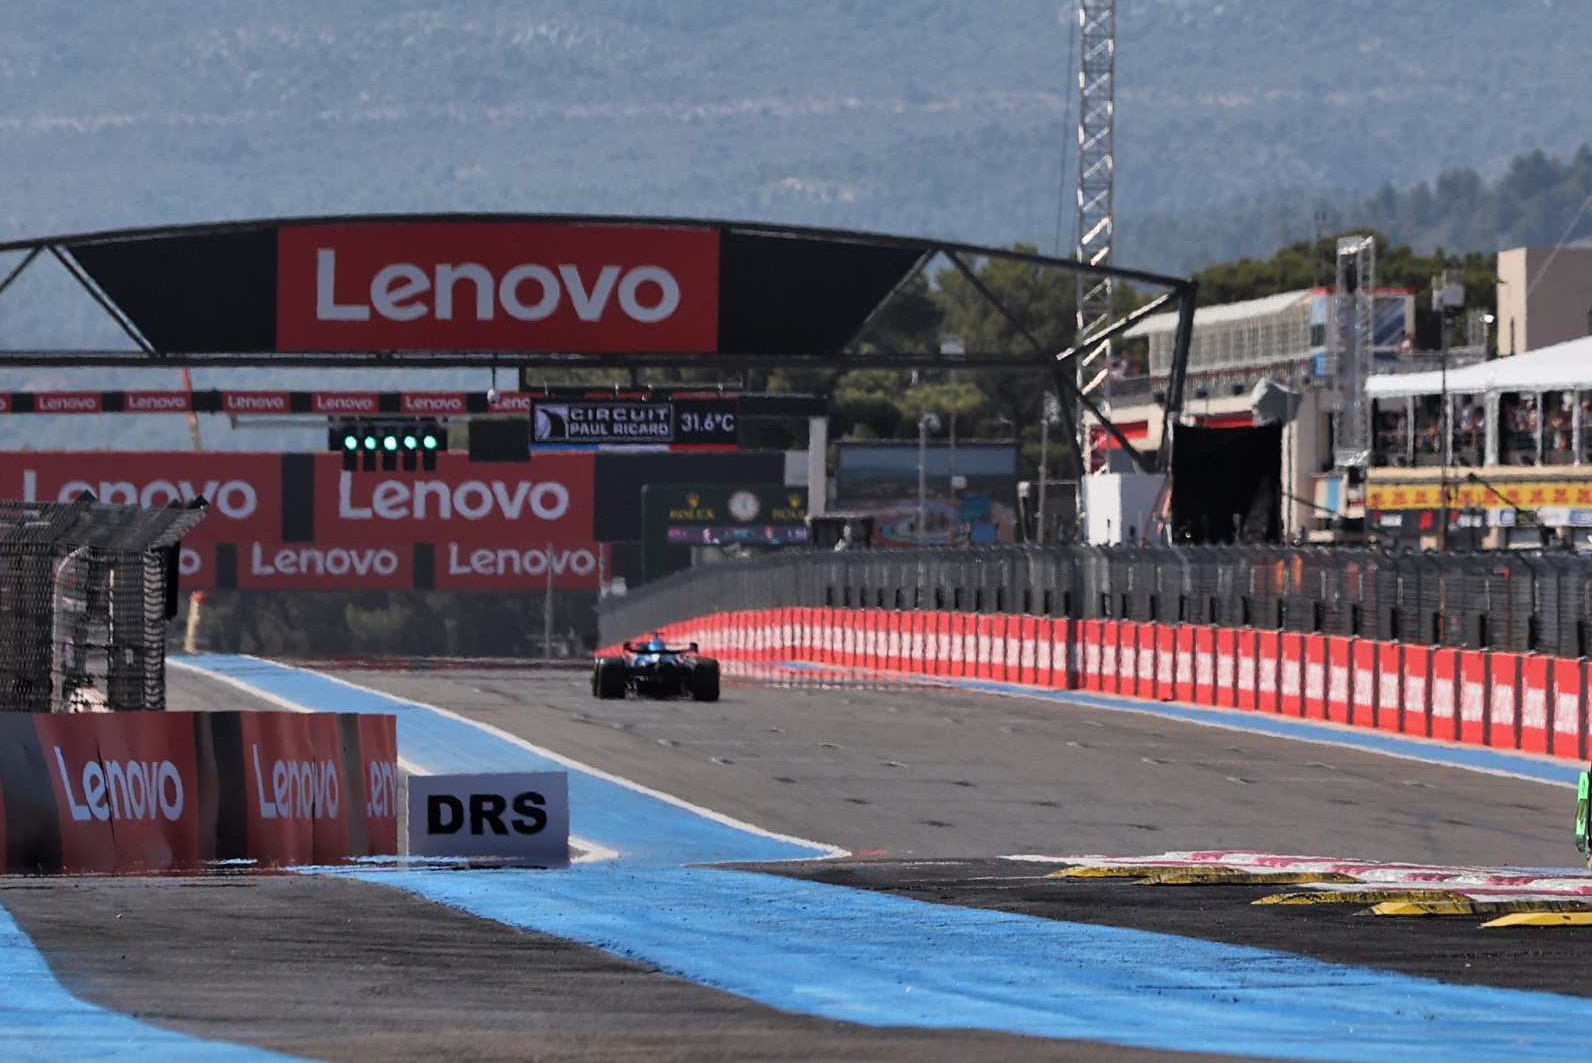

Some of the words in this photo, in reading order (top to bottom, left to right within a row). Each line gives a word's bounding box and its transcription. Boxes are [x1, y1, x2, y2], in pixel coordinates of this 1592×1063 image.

[316, 248, 681, 323] Lenovo
[39, 396, 97, 411] Lenovo
[128, 395, 187, 410] Lenovo
[227, 395, 284, 410] Lenovo
[316, 396, 373, 411] Lenovo
[405, 396, 462, 411] Lenovo
[570, 408, 670, 421] CIRCUIT
[681, 413, 735, 433] 31.6°C
[570, 423, 608, 436] PAUL
[613, 423, 670, 436] RICARD
[338, 469, 570, 520] Lenovo
[251, 541, 398, 576] Lenovo
[449, 541, 596, 576] Lenovo
[53, 745, 185, 822] Lenovo
[252, 744, 339, 819] Lenovo
[427, 791, 548, 835] DRS
